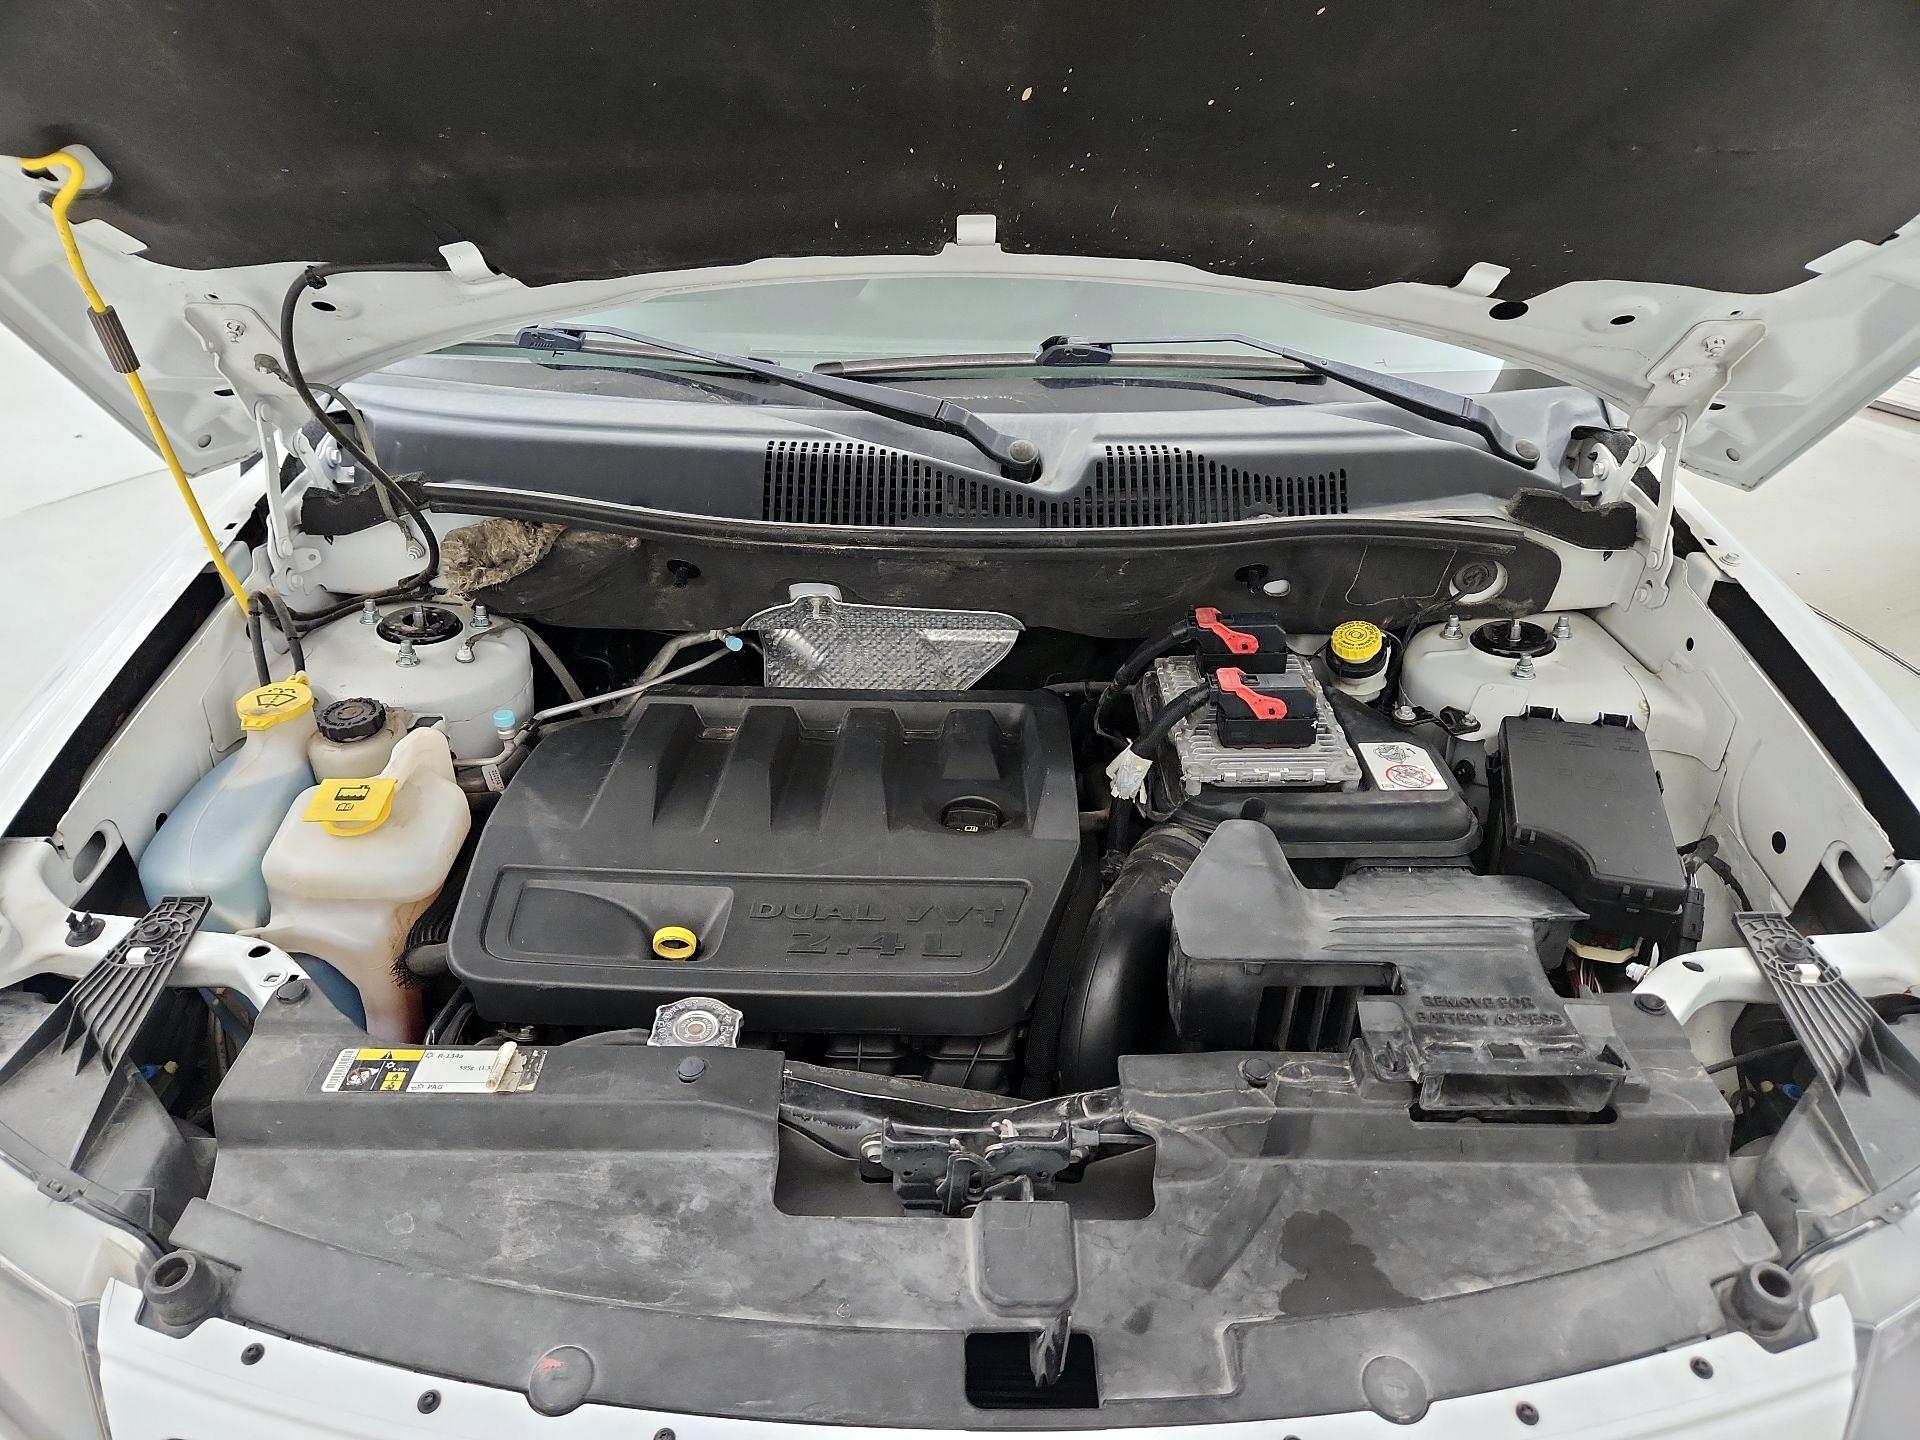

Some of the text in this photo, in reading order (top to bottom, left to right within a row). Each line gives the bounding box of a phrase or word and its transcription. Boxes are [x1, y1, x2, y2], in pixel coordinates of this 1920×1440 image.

[749, 902, 887, 922] DUAL
[1420, 995, 1537, 1010] REMOVE FOR
[1415, 1011, 1563, 1026] BATTERY ACCESS
